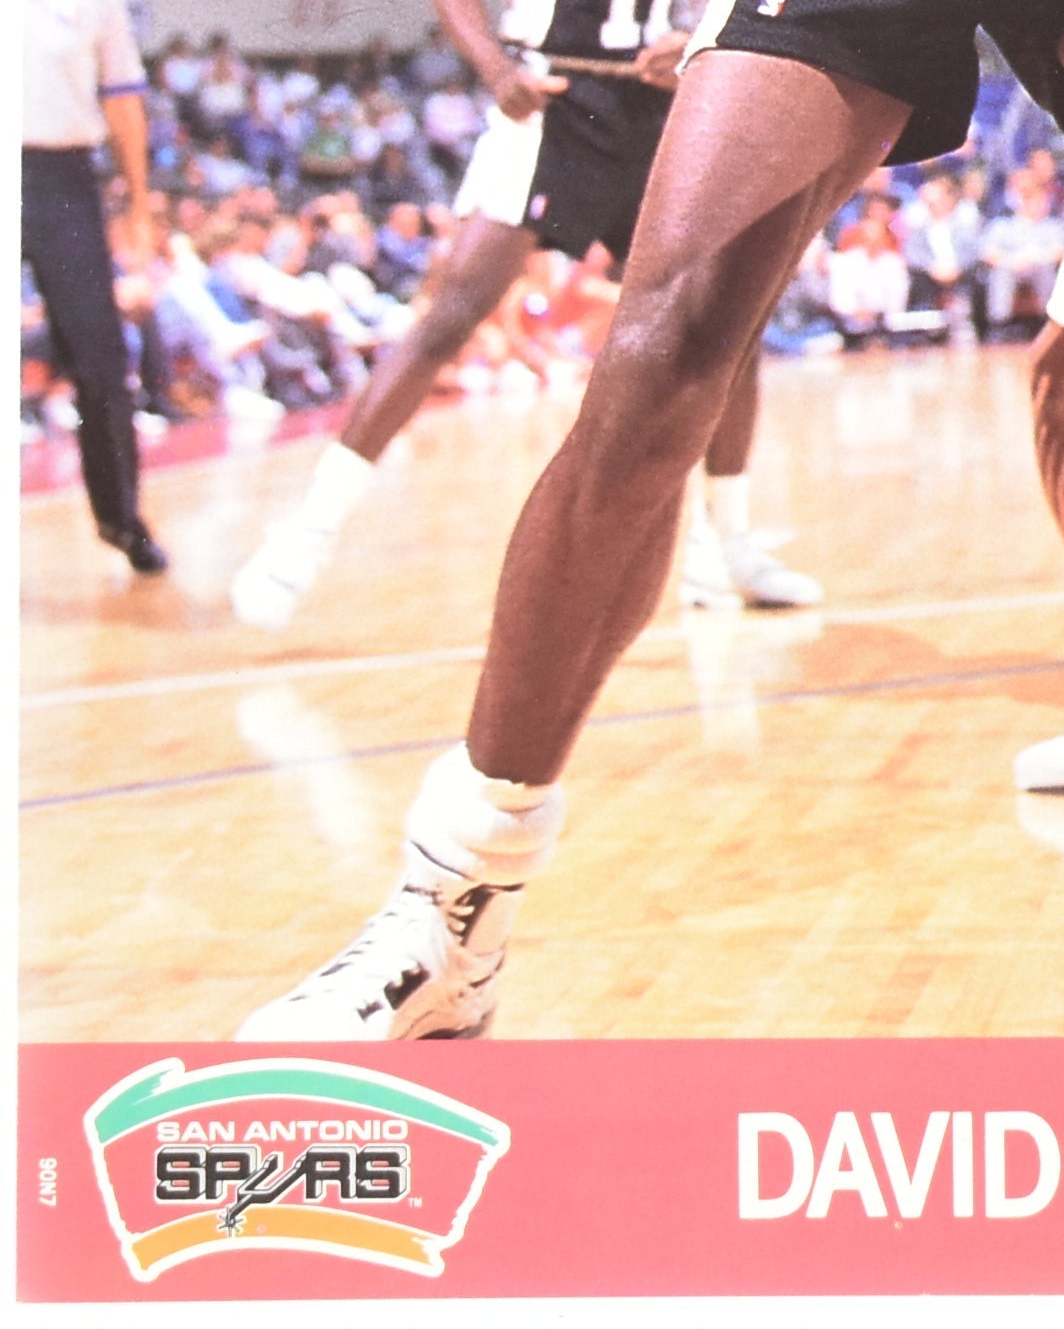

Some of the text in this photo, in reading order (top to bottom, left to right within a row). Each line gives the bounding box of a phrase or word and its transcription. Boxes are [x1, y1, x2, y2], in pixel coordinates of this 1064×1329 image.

[156, 1119, 409, 1142] SAN ANTONIO
[39, 1157, 58, 1207] 90N7
[155, 1143, 412, 1228] SPURS
[738, 1111, 1062, 1219] DAVID
